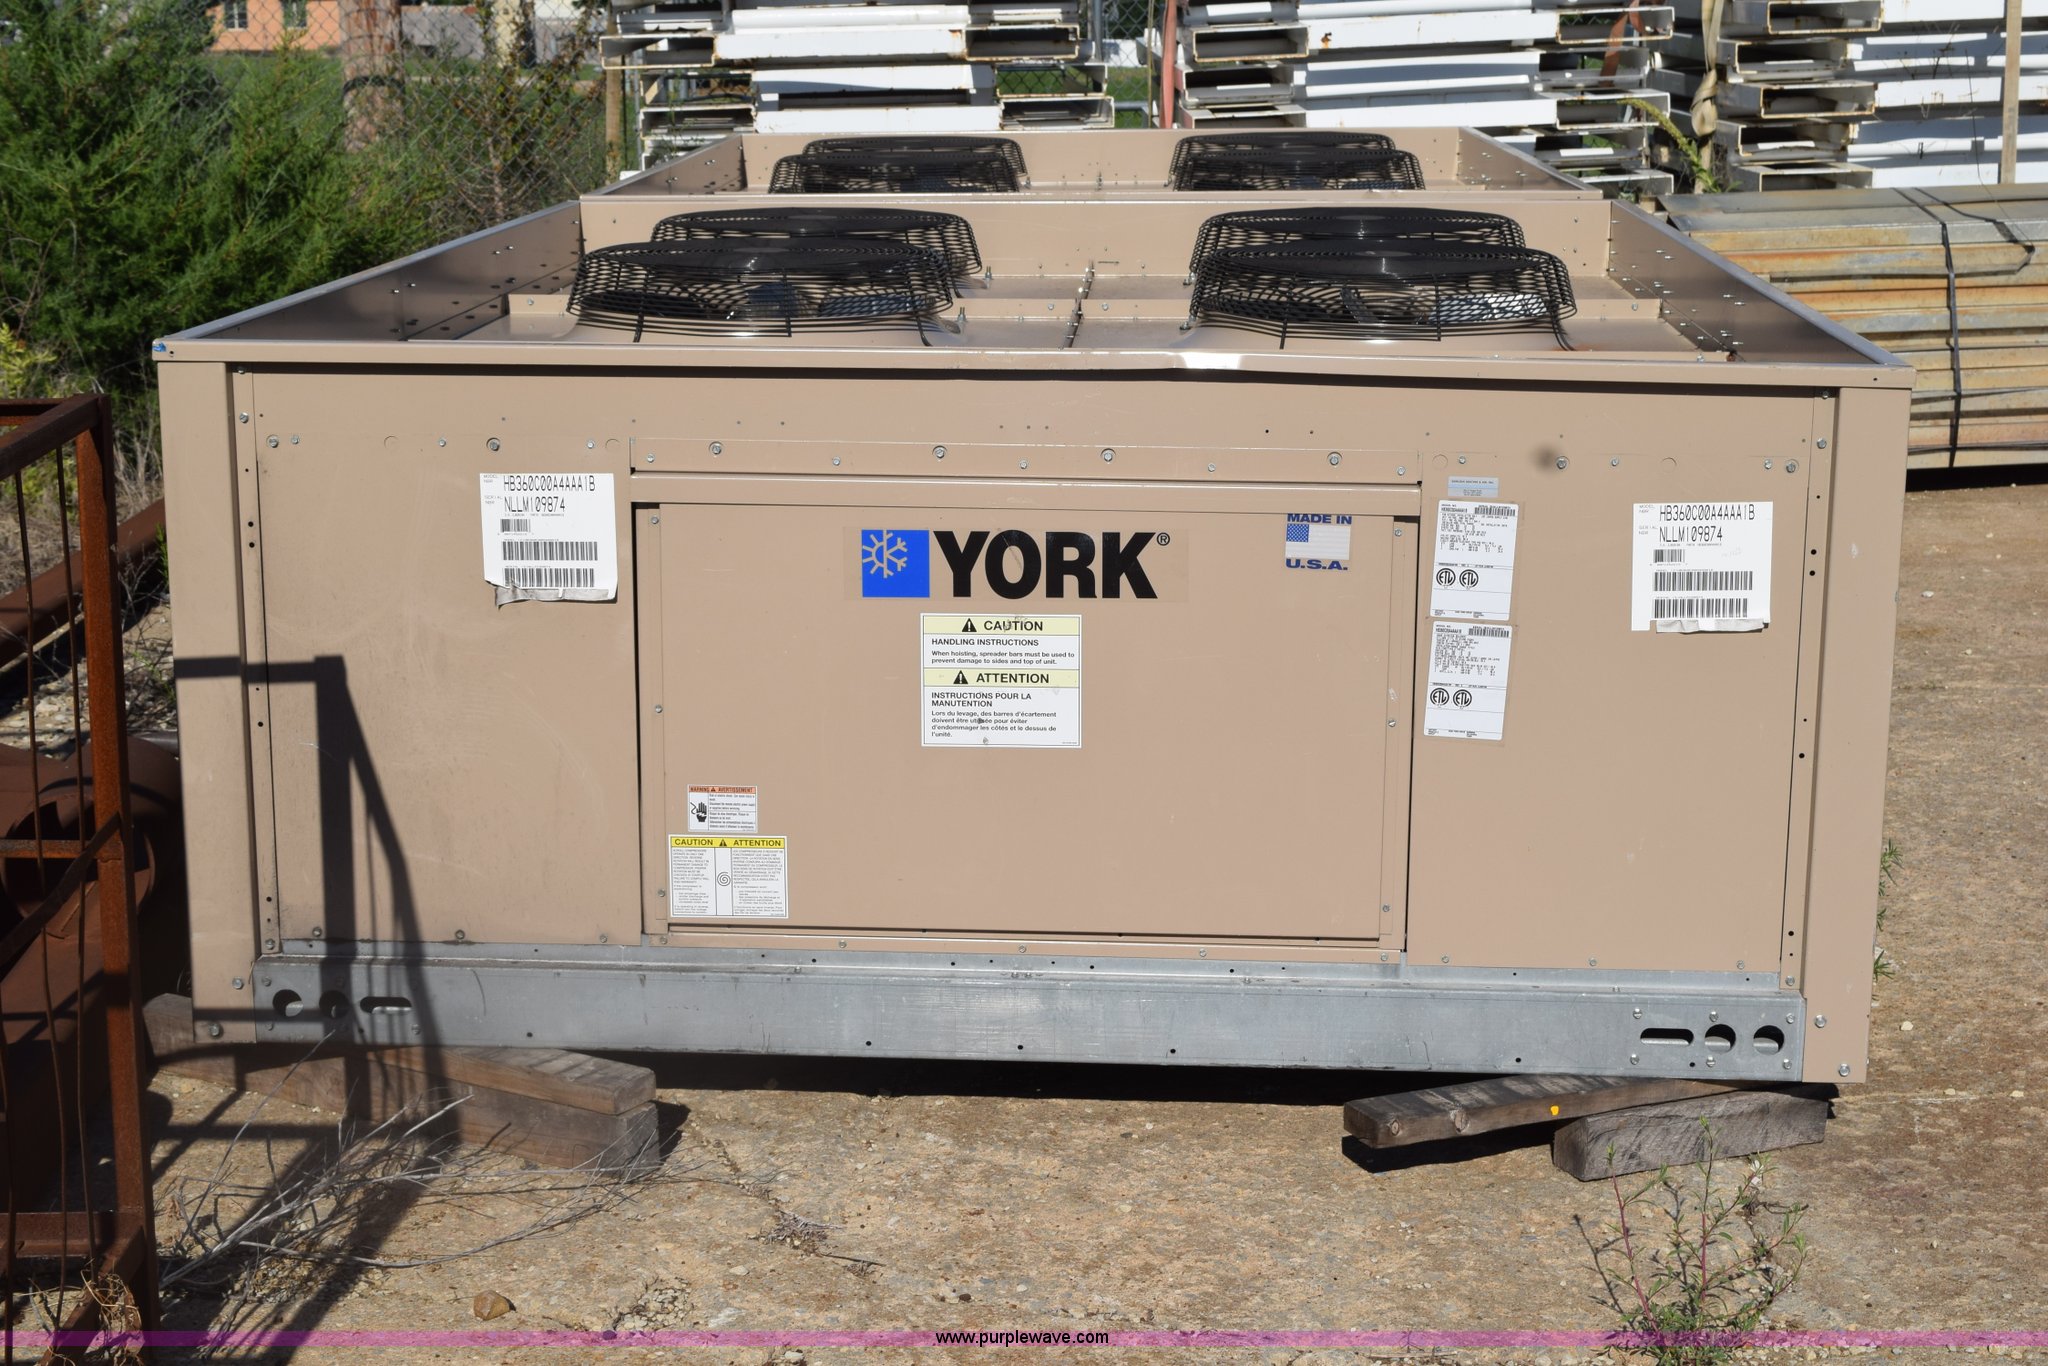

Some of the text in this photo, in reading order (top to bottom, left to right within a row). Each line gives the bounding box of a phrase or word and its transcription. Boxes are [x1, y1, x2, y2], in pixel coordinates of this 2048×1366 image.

[1287, 513, 1352, 524] MADE IN
[1286, 558, 1348, 570] U.S.A.
[983, 621, 1043, 631] CAUTION
[976, 673, 1049, 683] ATTENTION
